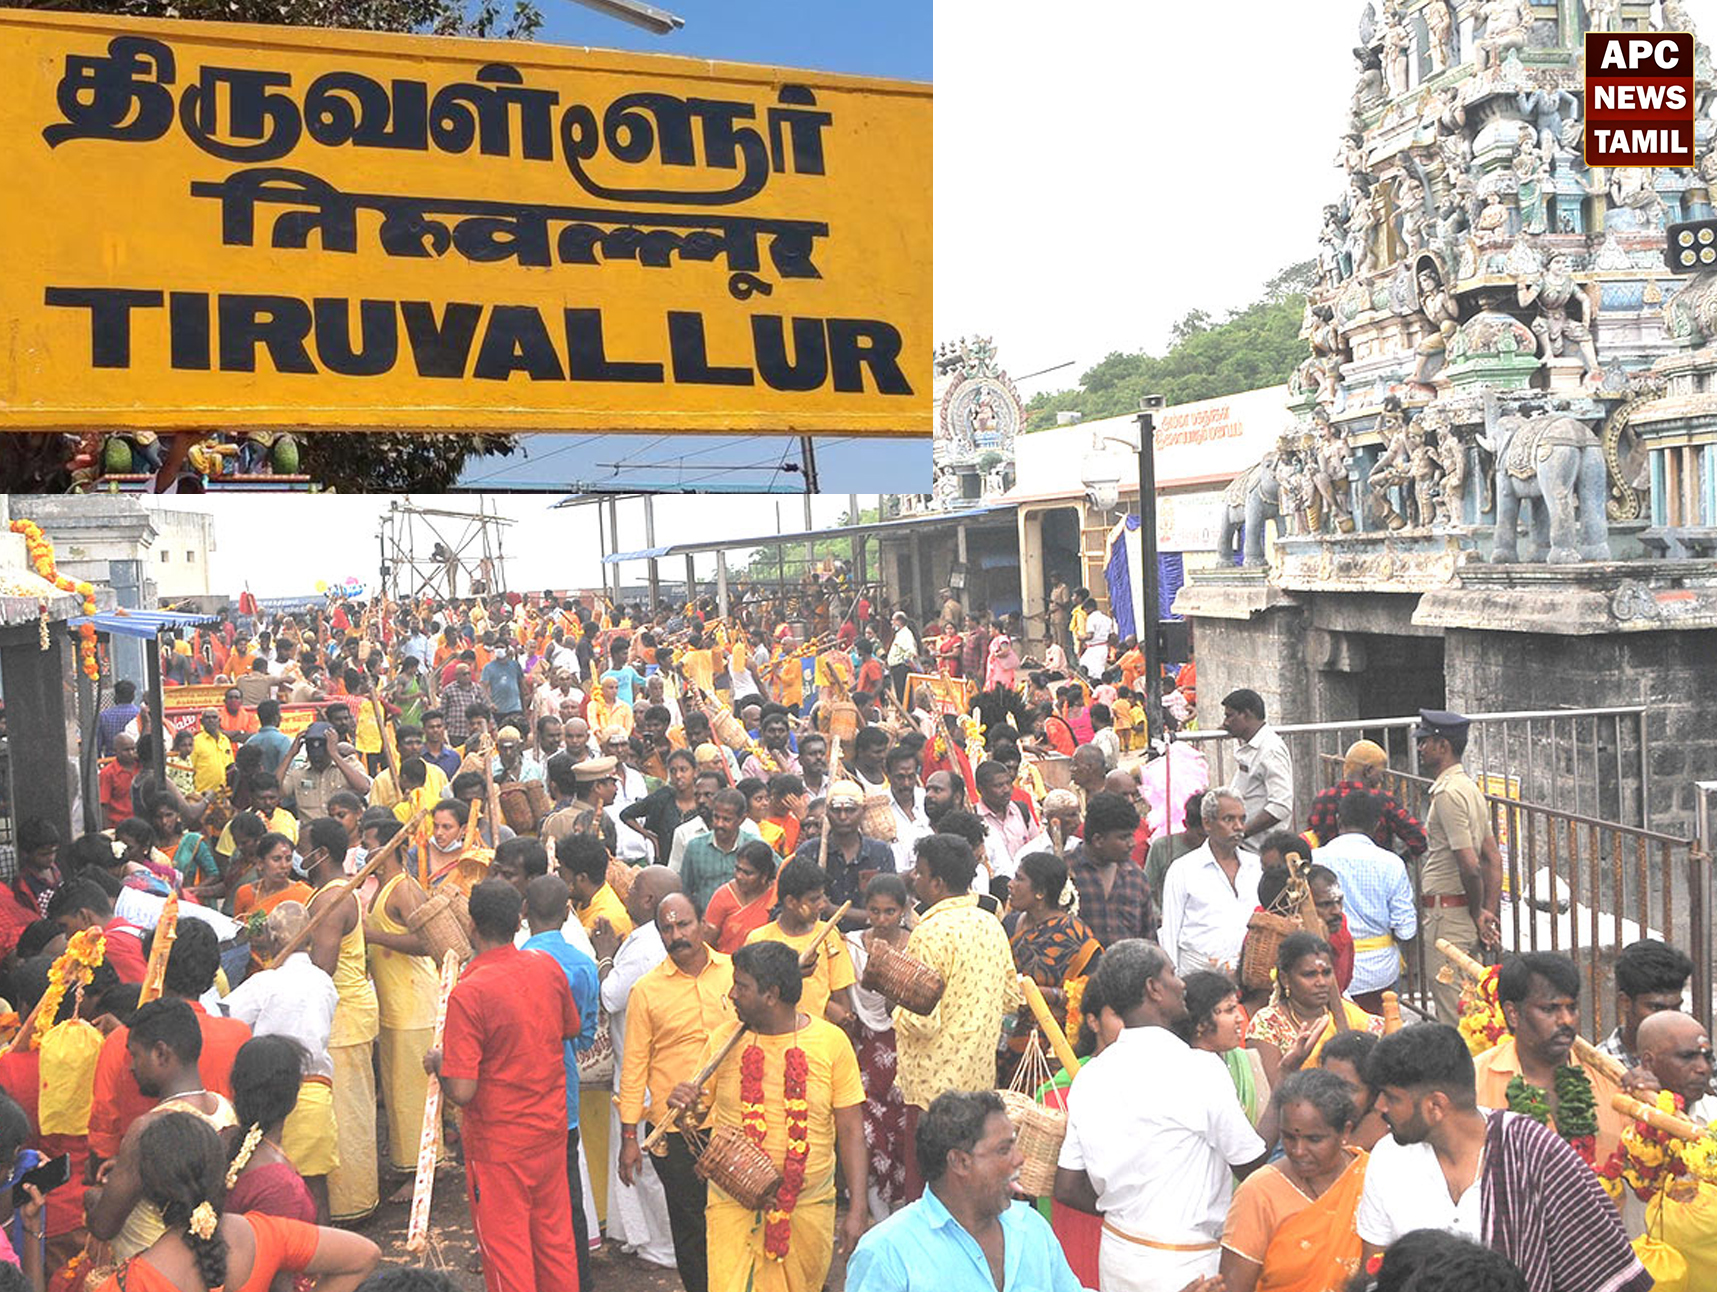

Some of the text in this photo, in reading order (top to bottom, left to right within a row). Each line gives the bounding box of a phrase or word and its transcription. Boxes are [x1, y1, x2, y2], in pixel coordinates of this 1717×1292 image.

[42, 35, 832, 205] திருவள்ளூர்
[191, 166, 828, 301] तिरुवल्लूर
[45, 286, 914, 396] TIRUVALLUR
